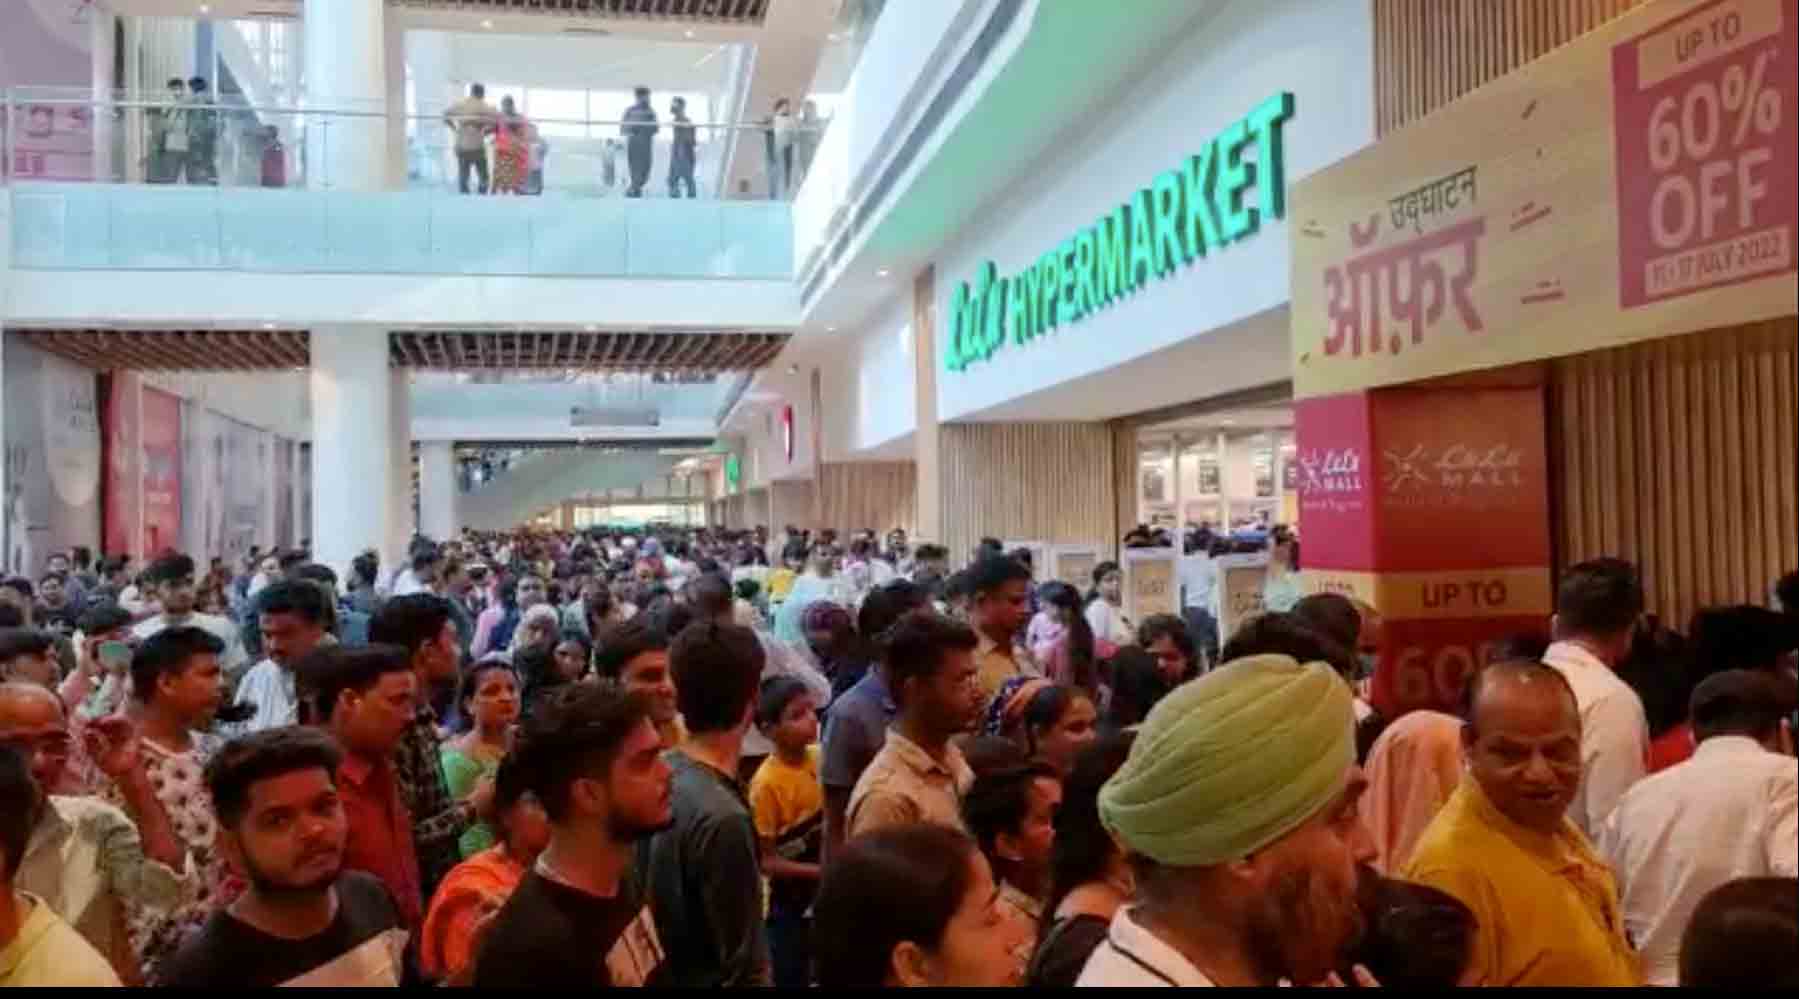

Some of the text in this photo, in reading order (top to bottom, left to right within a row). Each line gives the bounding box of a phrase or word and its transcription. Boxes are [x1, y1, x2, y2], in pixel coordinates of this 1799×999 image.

[1676, 10, 1742, 62] UP TO
[1649, 50, 1782, 170] 60%
[1011, 91, 1294, 345] HYPERMARKET
[1651, 148, 1771, 249] OFF
[1421, 579, 1506, 607] UP TO
